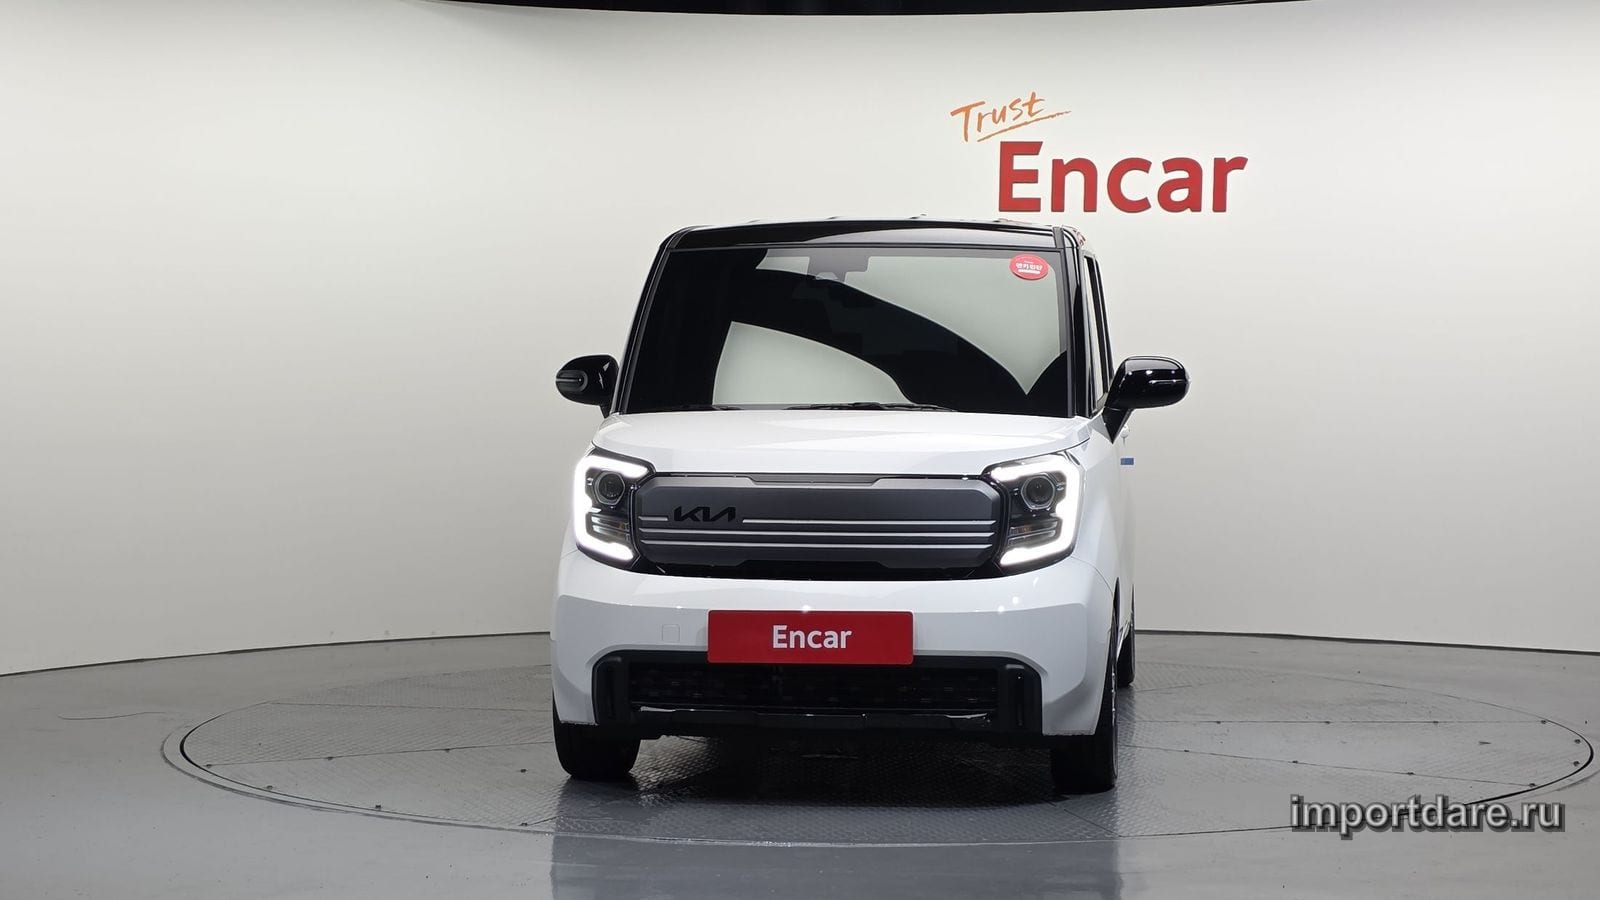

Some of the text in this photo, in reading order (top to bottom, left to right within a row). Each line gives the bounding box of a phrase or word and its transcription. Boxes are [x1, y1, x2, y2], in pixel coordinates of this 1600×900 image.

[950, 91, 1045, 141] Trust
[998, 141, 1248, 213] Encar
[673, 506, 736, 522] KIA
[772, 624, 853, 649] Encar
